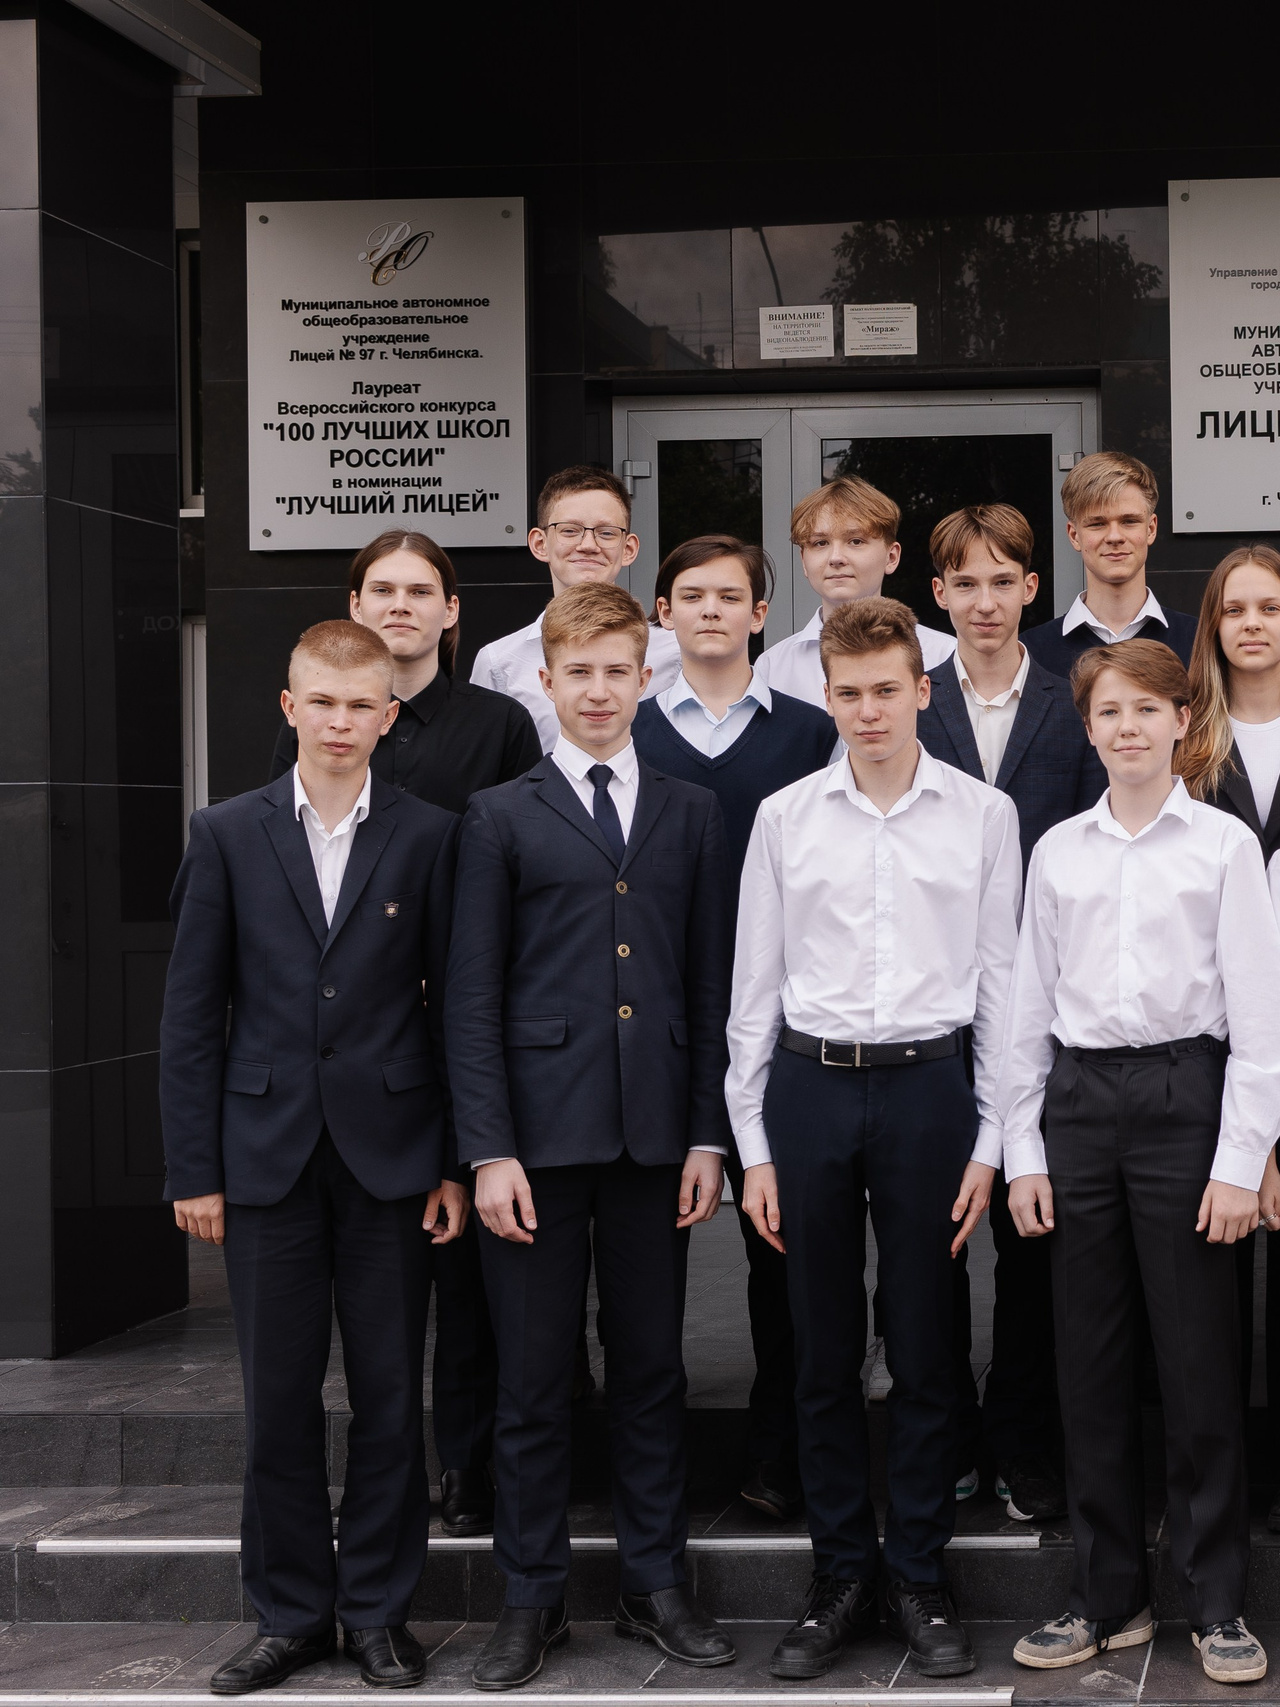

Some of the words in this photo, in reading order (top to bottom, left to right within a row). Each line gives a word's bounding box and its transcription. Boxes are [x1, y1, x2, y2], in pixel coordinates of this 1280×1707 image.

[1209, 268, 1277, 279] Управление
[282, 299, 398, 313] Муниципальное
[403, 298, 489, 308] автономное
[302, 313, 469, 328] общеобразовательное
[768, 312, 825, 321] ВНИМАНИЕ!
[862, 326, 899, 334] «Мираж»
[342, 332, 430, 347] учреждение
[290, 349, 334, 363] Лицей
[340, 349, 355, 360] №
[359, 349, 375, 360] 97
[380, 351, 388, 359] г.
[393, 347, 483, 359] Челябинска.
[352, 382, 421, 398] Лауреат
[278, 400, 415, 417] Всероссийского
[420, 401, 495, 415] конкурса
[264, 423, 314, 441] "100
[322, 420, 429, 440] ЛУЧШИХ
[437, 419, 509, 438] ШКОЛ
[330, 448, 445, 468] РОССИИ"
[333, 479, 342, 488] в
[348, 477, 441, 489] номинации
[276, 491, 394, 515] "ЛУЧШИЙ
[402, 489, 500, 516] ЛИЦЕЙ"
[1263, 496, 1271, 505] г.
